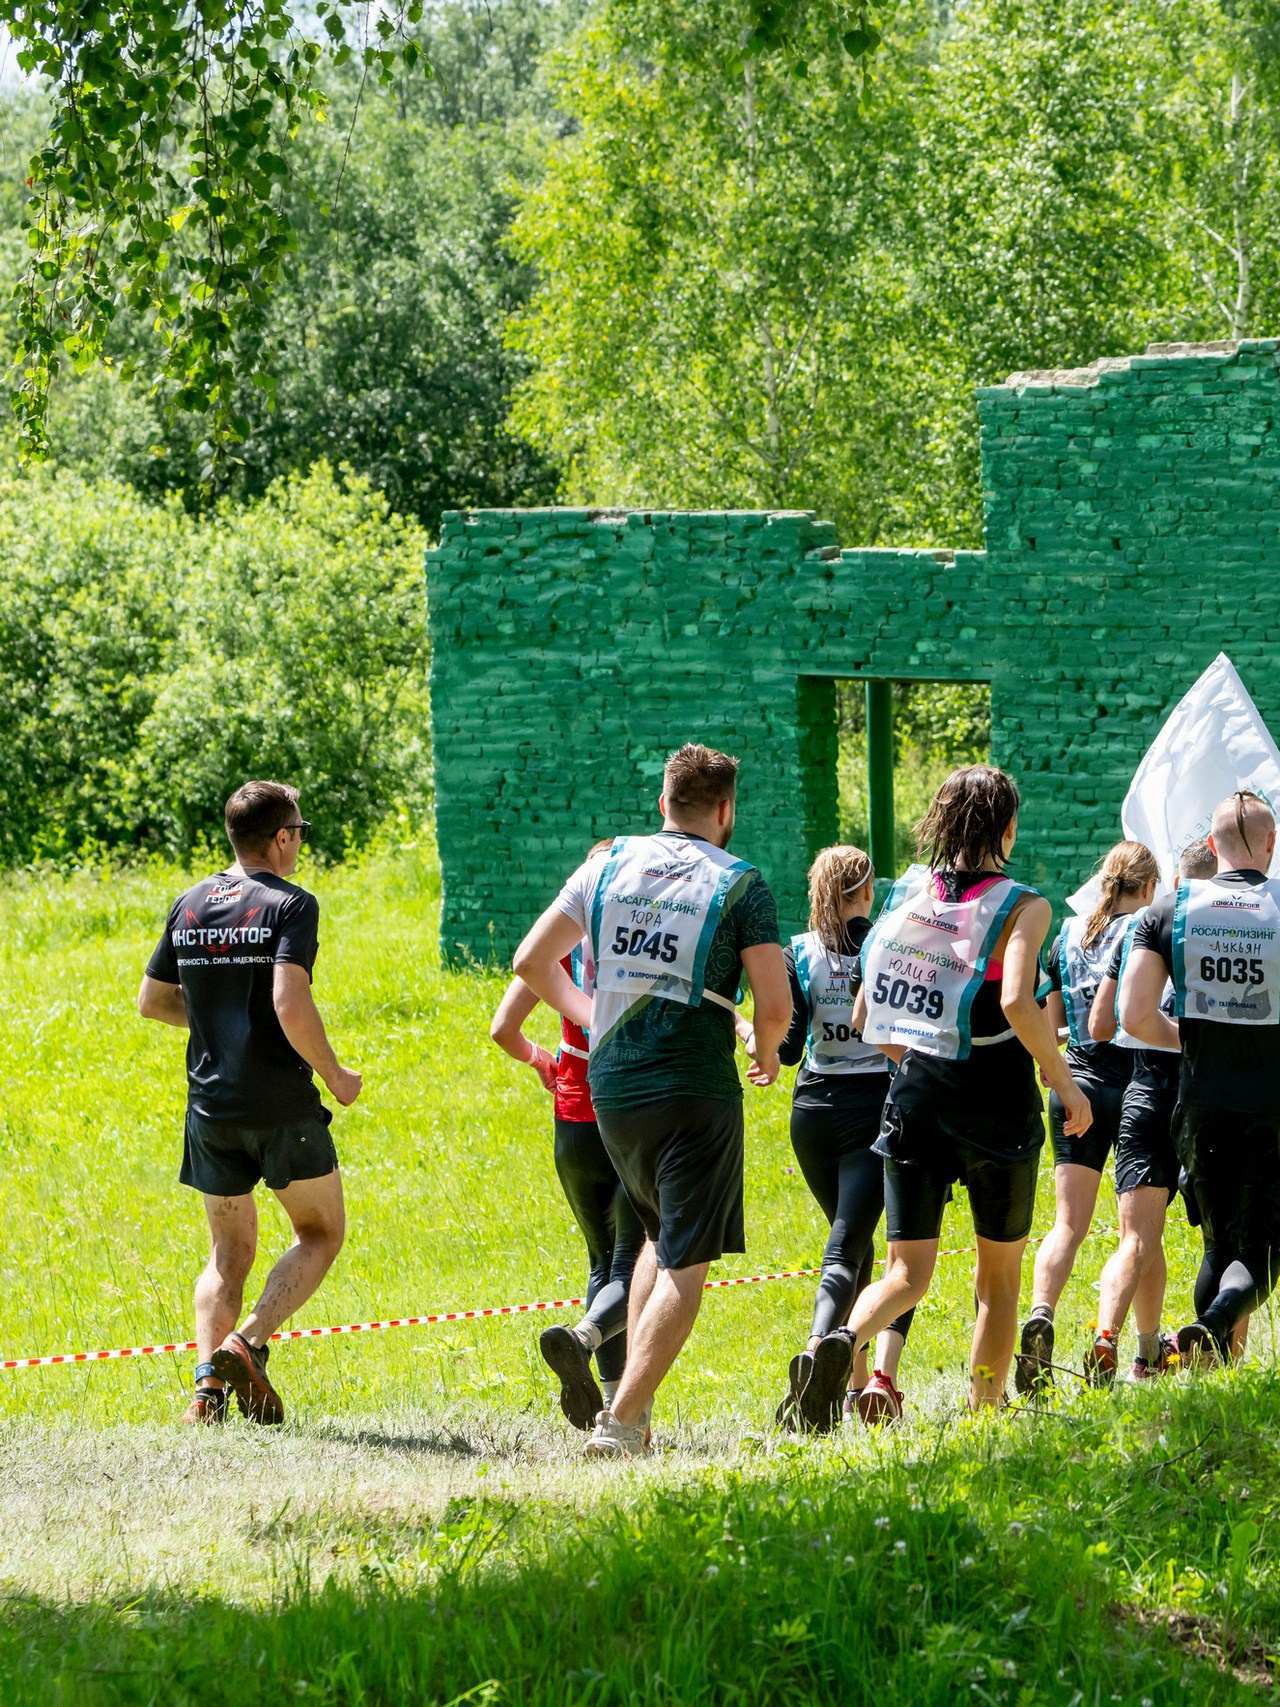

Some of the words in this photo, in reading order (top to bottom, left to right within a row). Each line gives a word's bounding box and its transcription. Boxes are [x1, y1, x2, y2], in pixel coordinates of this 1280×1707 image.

[205, 894, 241, 904] ГЕРОЕВ
[611, 893, 701, 916] РОСАГРОЛИЗИНГ
[1235, 901, 1260, 909] ГЕРОЕВ
[630, 909, 663, 928] ЮРА
[907, 911, 931, 924] ГОНКА
[932, 919, 959, 932] ГЕРОЕВ
[172, 927, 273, 947] ИНСТРУКТОР
[1191, 927, 1277, 941] РОСАГРОЛИЗИНГ
[611, 926, 679, 964] 5045
[878, 937, 968, 974] РОСАГРОЛИЗИНГ
[1209, 940, 1262, 956] ЛУКЬЯН
[213, 956, 230, 965] СИЛА
[888, 958, 938, 984] ЮЛИЯ
[1200, 955, 1265, 985] 6035
[872, 972, 944, 1021] 5039
[822, 1021, 864, 1044] 504
